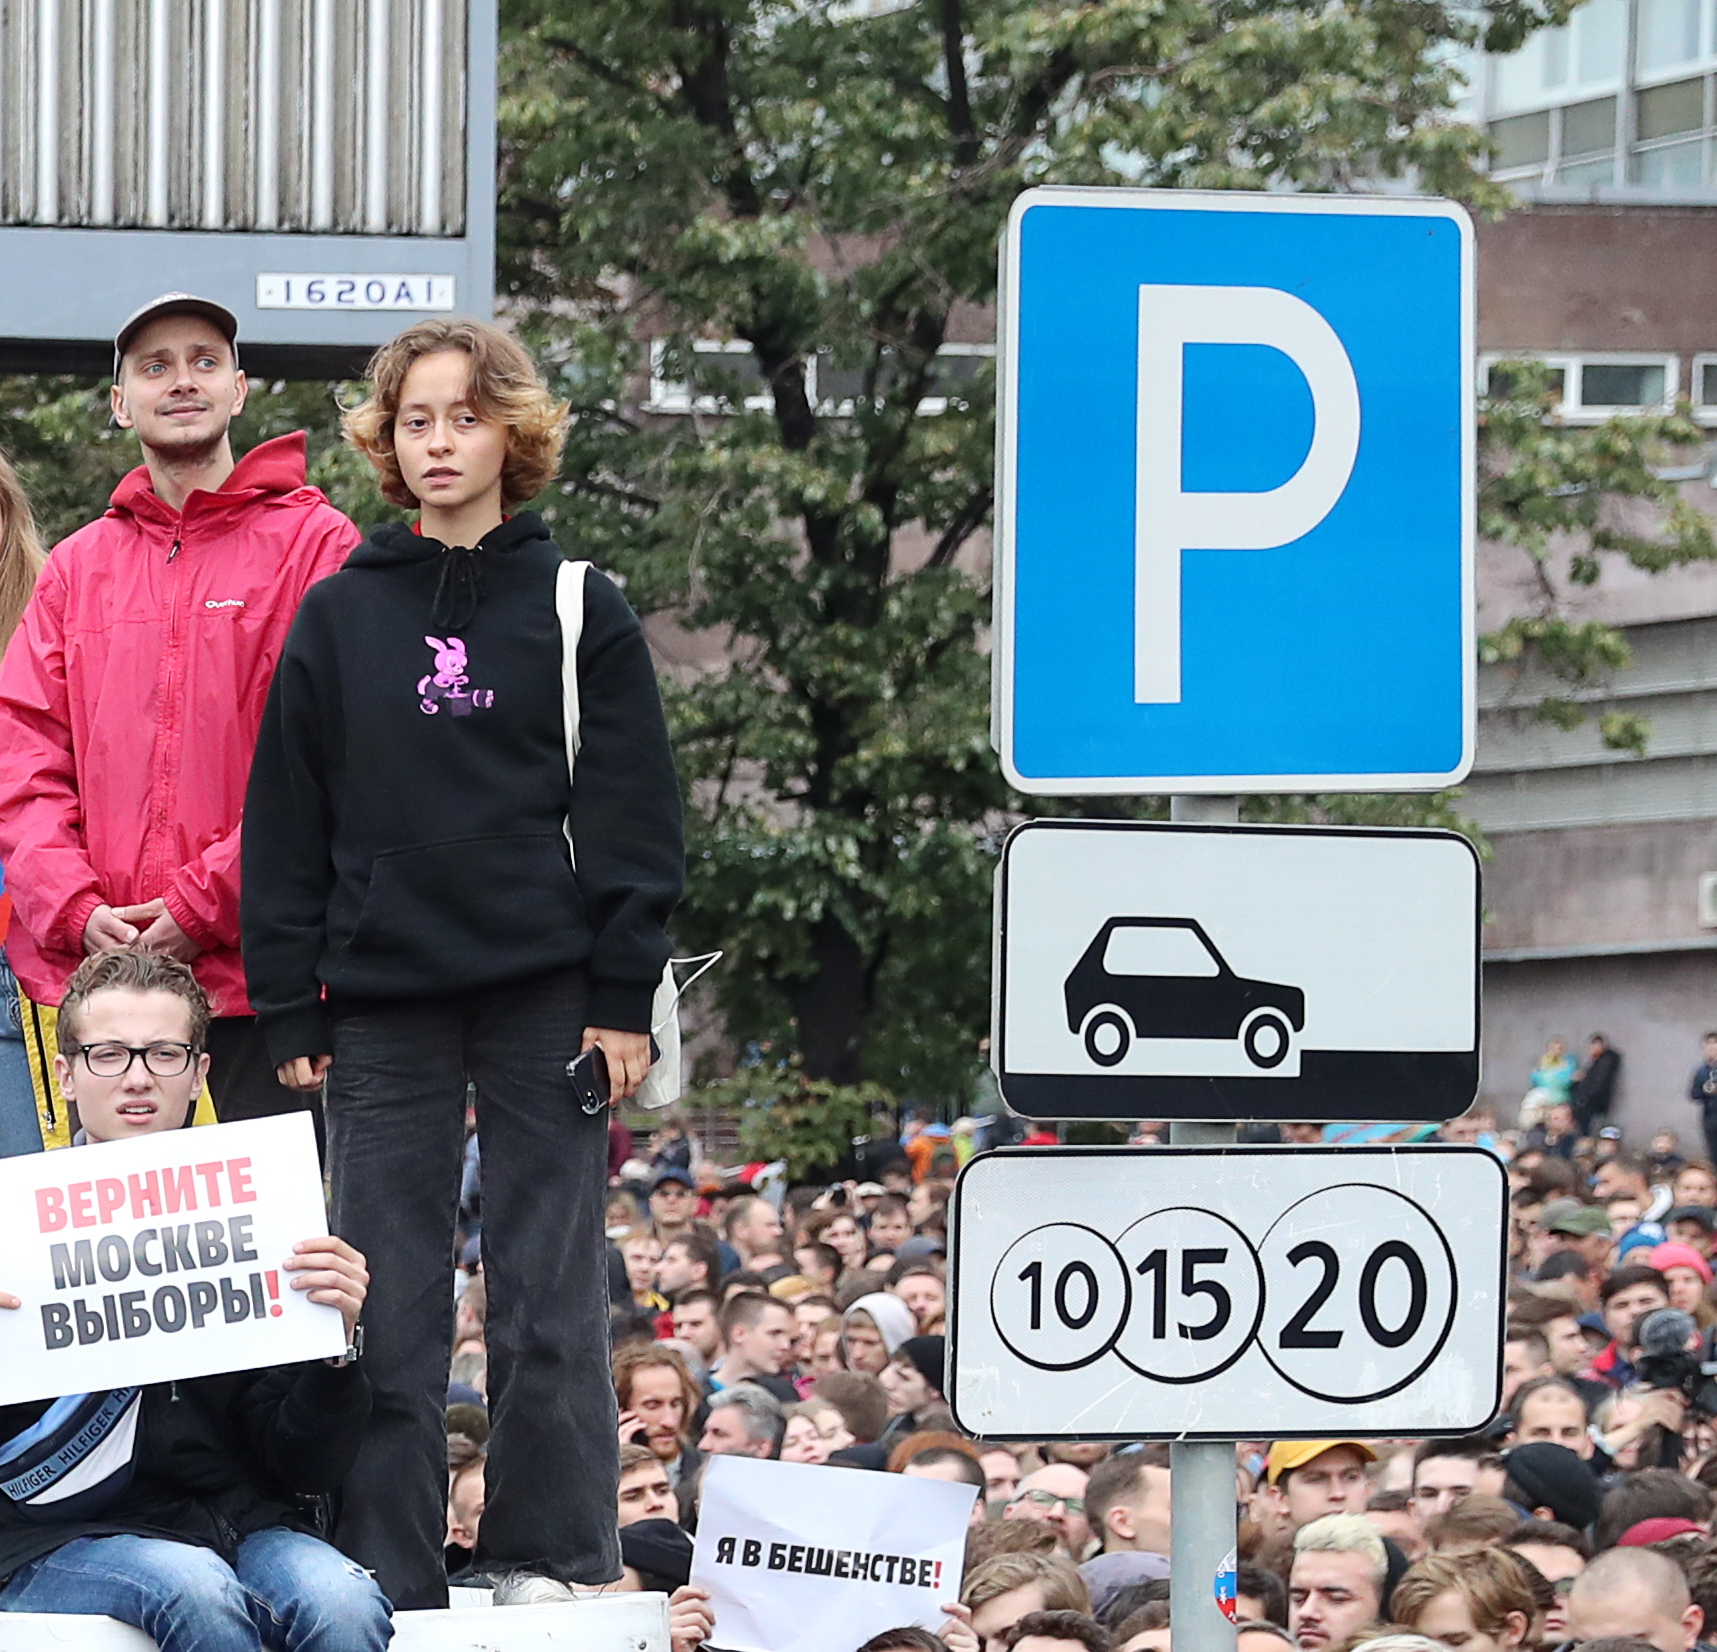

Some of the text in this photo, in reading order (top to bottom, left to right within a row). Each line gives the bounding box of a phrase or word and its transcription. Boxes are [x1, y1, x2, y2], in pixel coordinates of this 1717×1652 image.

[1134, 284, 1361, 704] P
[34, 1157, 257, 1234] ВЕРНИТЕ
[49, 1214, 259, 1290] МОСКВЕ
[40, 1269, 284, 1350] ВЫБОРЫ!
[1018, 1240, 1427, 1349] 10 15 20
[58, 1407, 114, 1466] HILFIGER
[6, 1465, 57, 1498] HILFIGER
[715, 1537, 943, 1590] Я В БЕШЕНСТВЕ!
